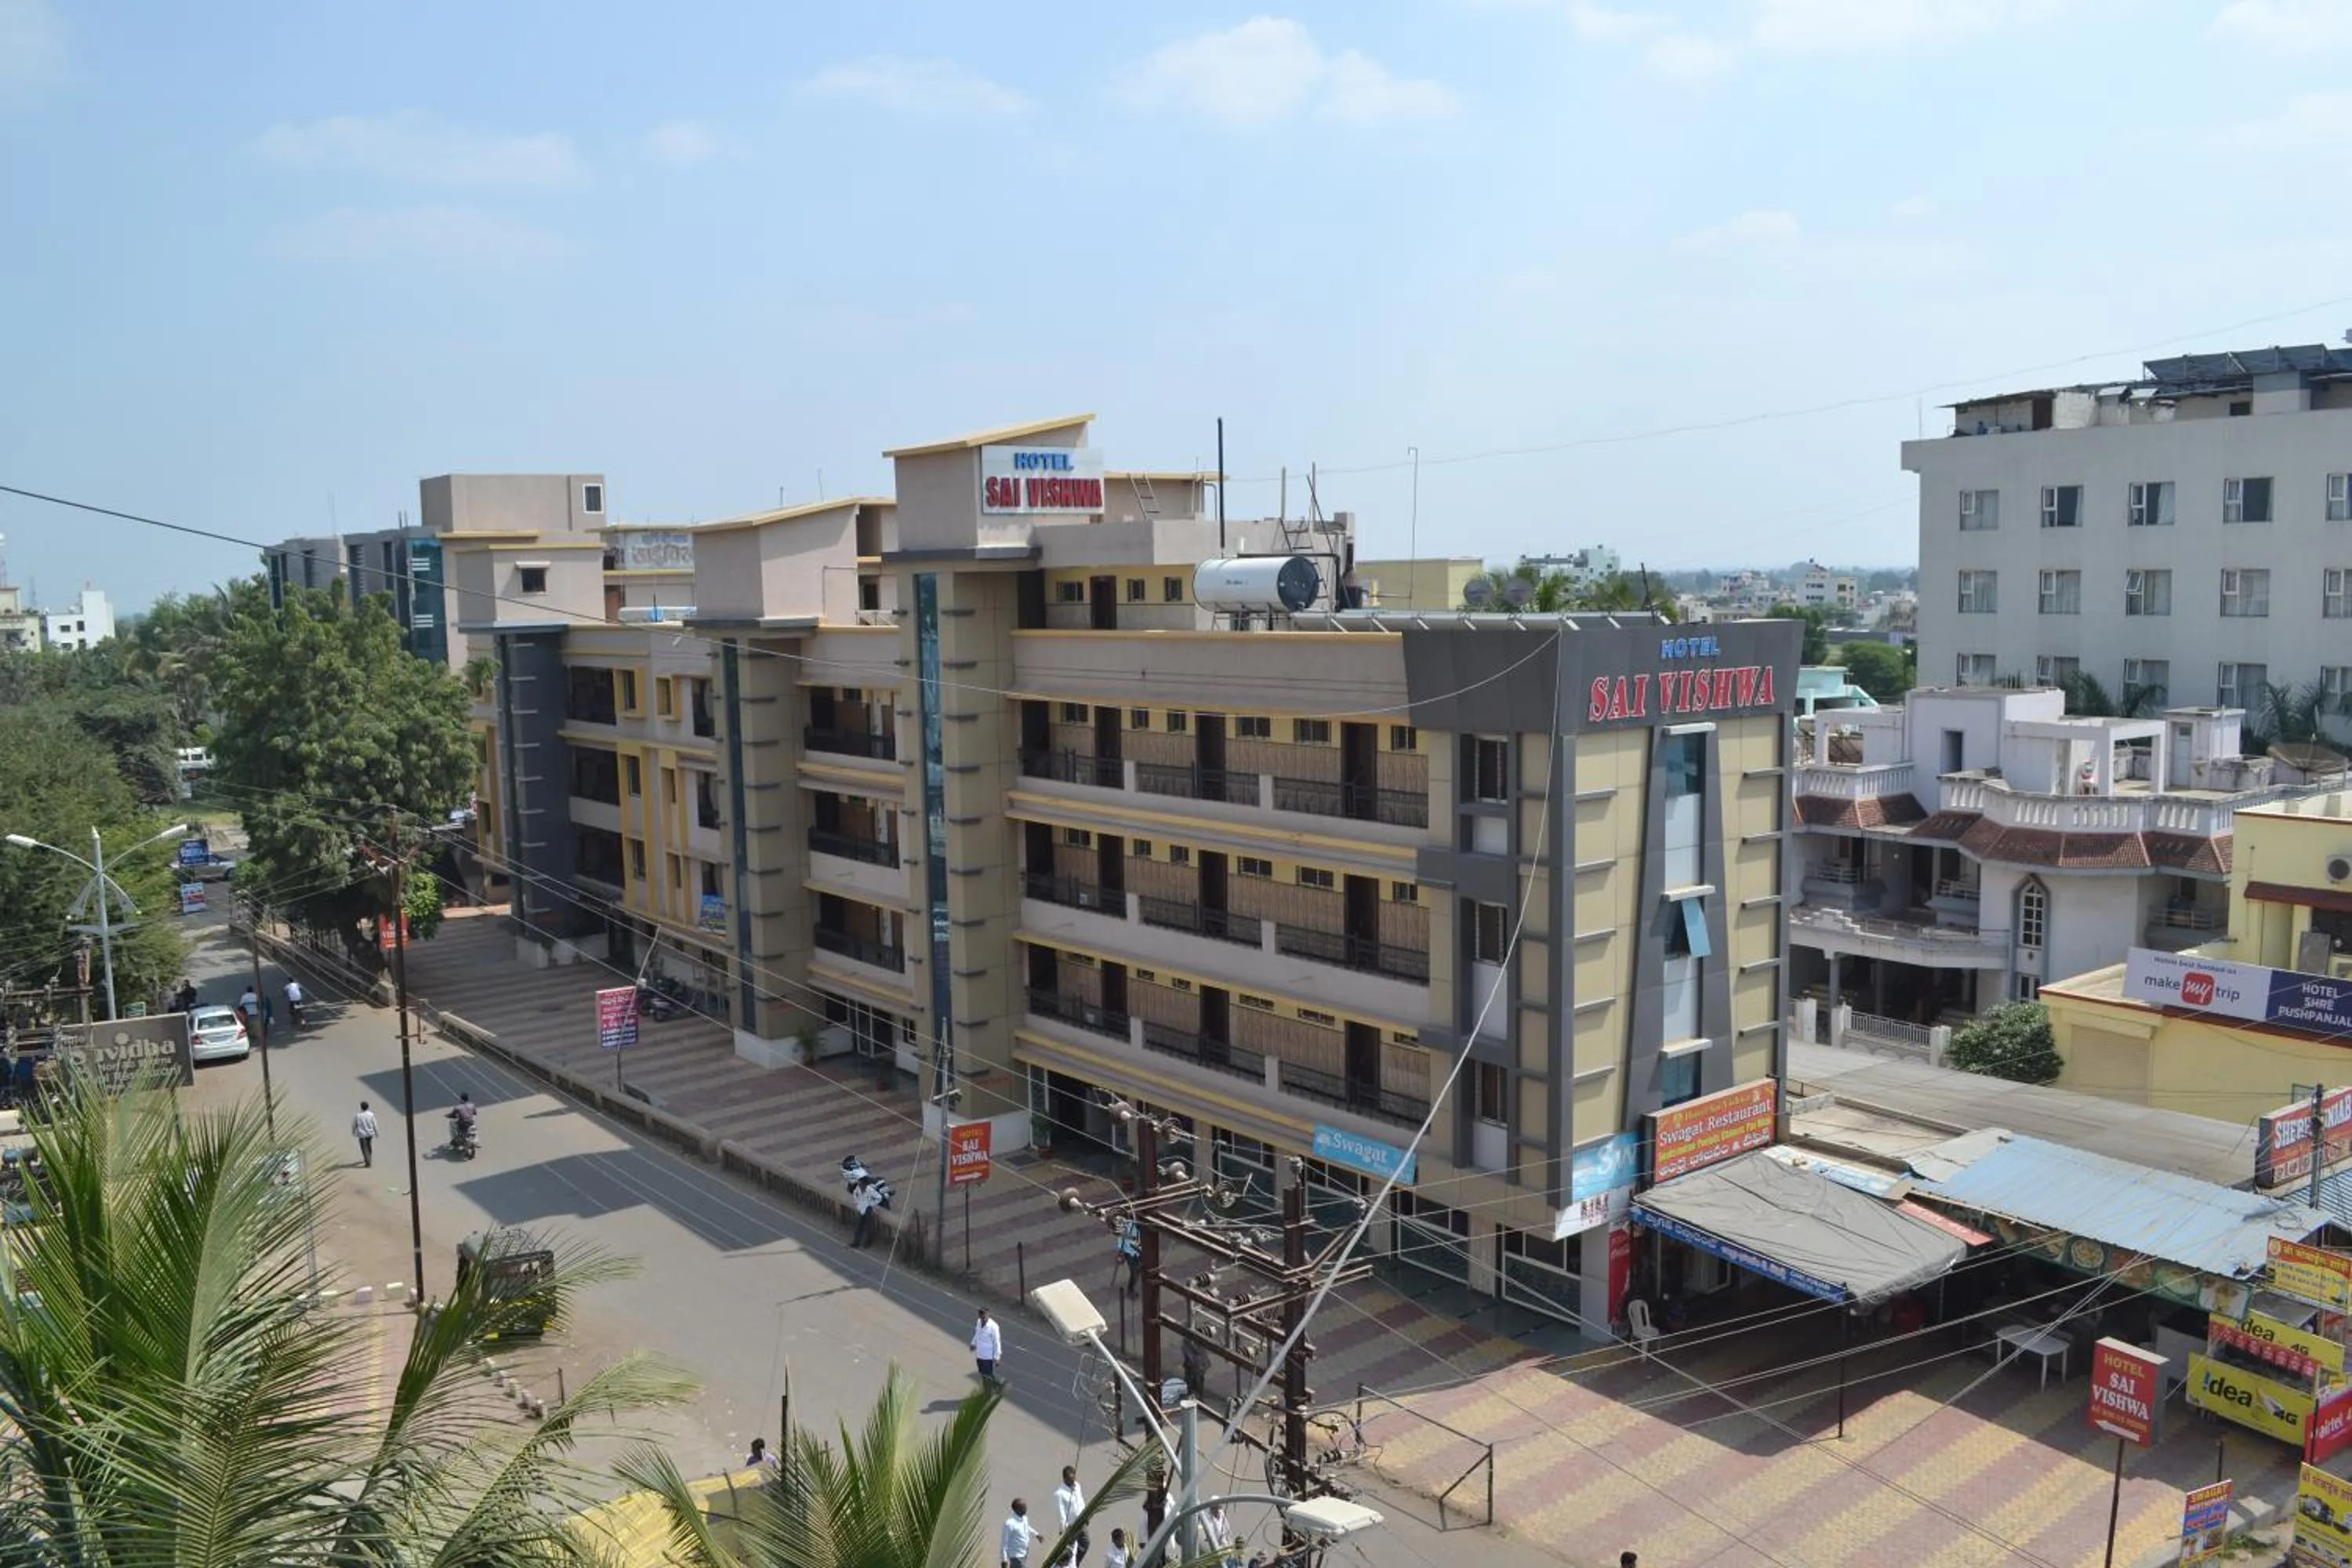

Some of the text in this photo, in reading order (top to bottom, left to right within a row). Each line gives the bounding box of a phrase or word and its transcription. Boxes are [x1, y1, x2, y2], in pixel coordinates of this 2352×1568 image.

[1014, 452, 1074, 470] HOTEL
[985, 476, 1103, 507] SAI VISHWA
[1661, 636, 1720, 659] HOTEL
[1588, 666, 1775, 722] SAI VISHWA
[2144, 975, 2240, 1004] make my trip
[2302, 982, 2339, 999] HOTEL
[1660, 1120, 1704, 1148] Swagat
[1708, 1098, 1772, 1130] Restaurant
[952, 1150, 991, 1166] VISHWA
[962, 1138, 980, 1152] SAI
[1333, 1132, 1388, 1163] Swagat
[2103, 1352, 2146, 1380] HOTEL
[2109, 1372, 2136, 1396] SAI
[2092, 1383, 2151, 1421] VISHWA
[2319, 1411, 2343, 1439] airtel
